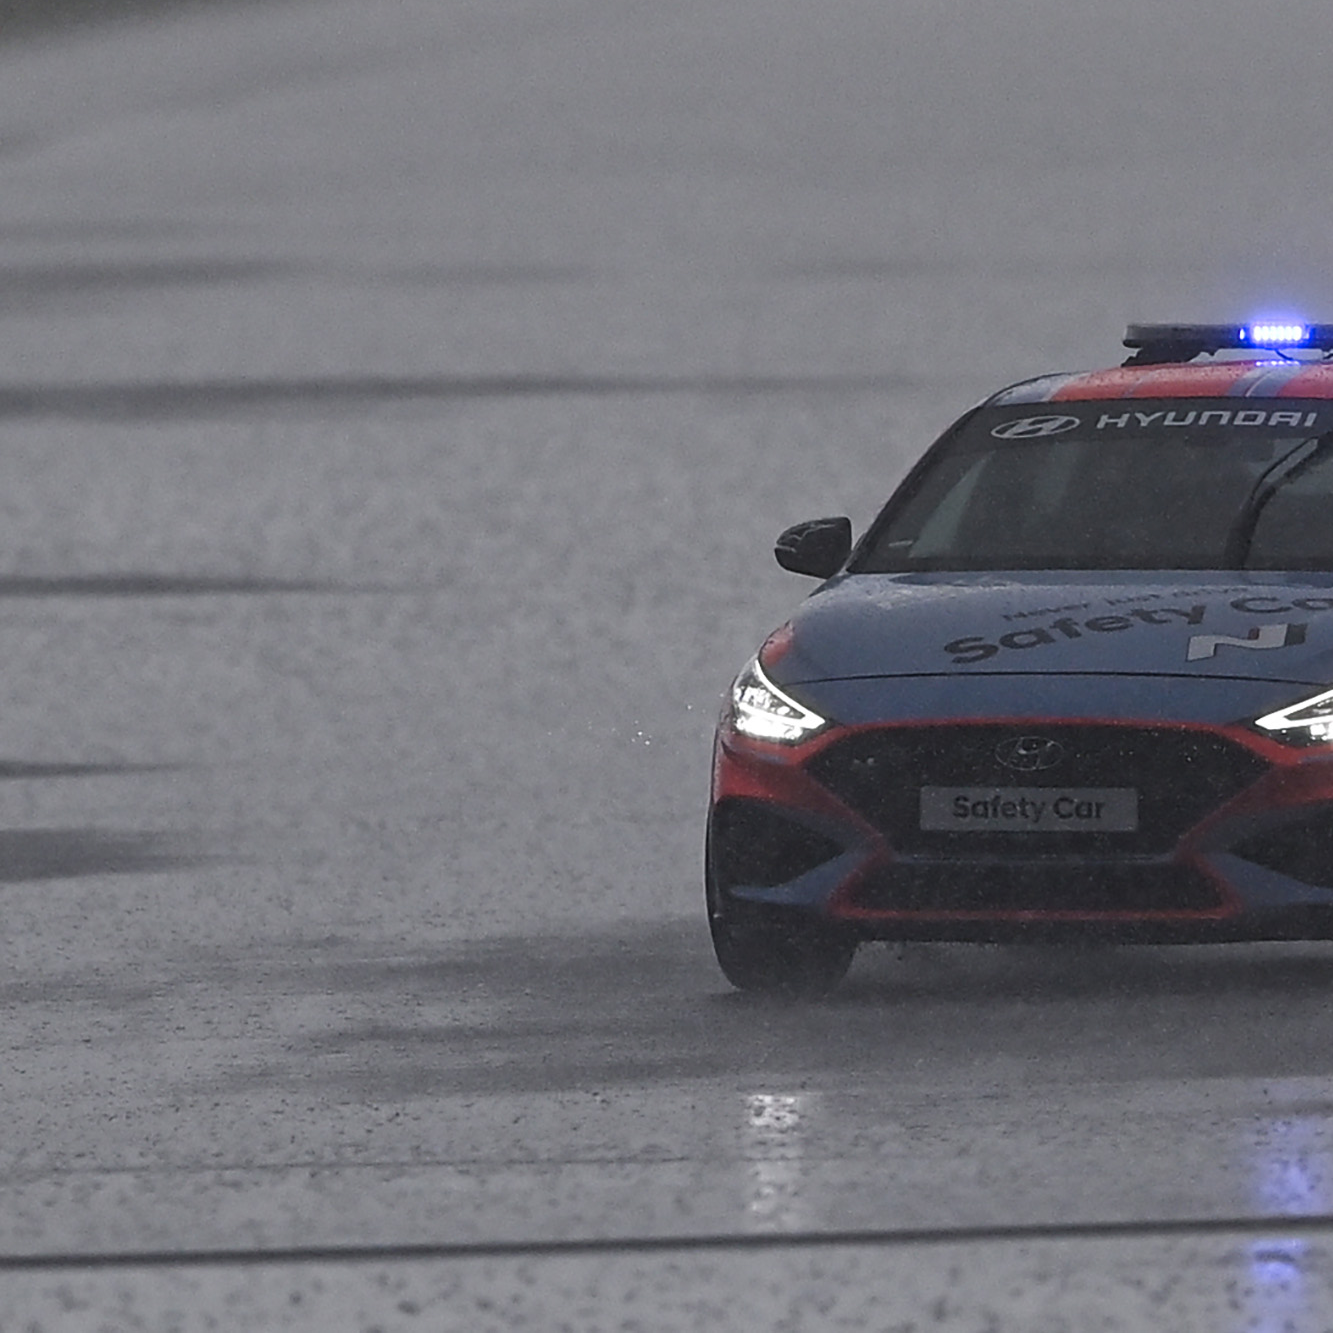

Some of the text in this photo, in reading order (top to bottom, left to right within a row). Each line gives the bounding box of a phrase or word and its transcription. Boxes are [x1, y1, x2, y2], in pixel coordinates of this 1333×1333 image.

[1095, 409, 1318, 430] HYUNDAI
[943, 604, 1207, 665] Safety
[951, 794, 1106, 824] Safety Car
